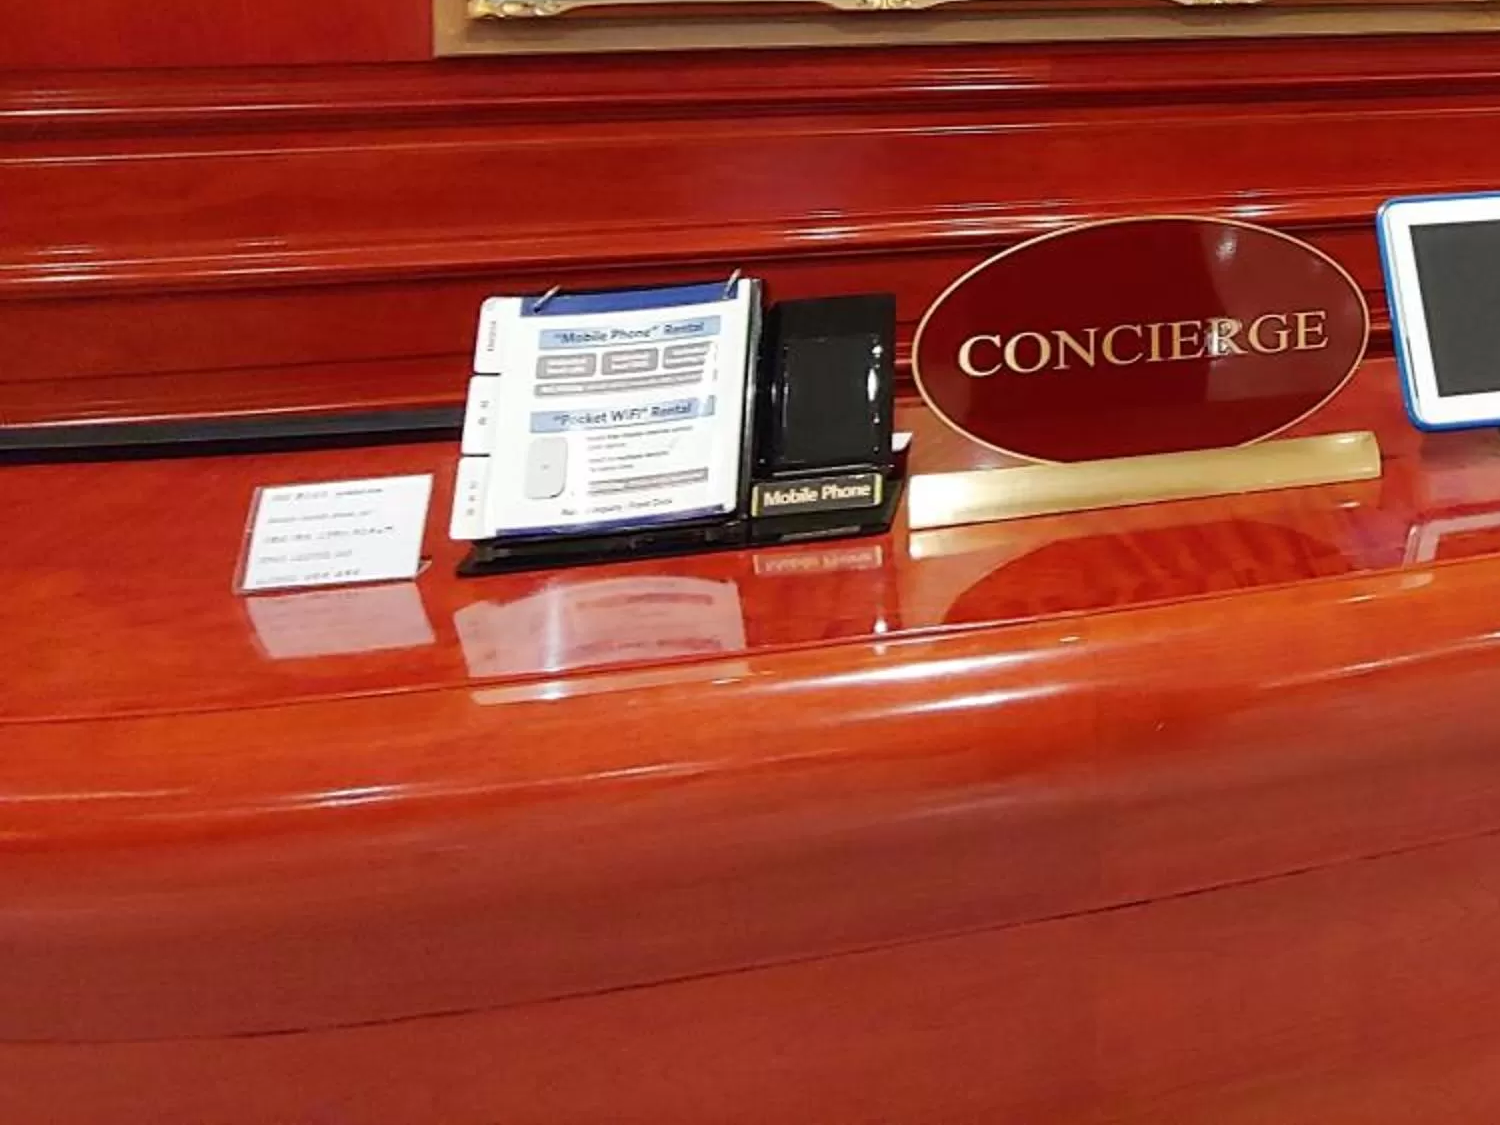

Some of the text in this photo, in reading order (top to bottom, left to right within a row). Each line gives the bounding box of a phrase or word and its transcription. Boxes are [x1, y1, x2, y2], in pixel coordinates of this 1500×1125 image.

[957, 309, 1329, 377] CONCIERGE
[763, 483, 871, 507] Mobile Phone
